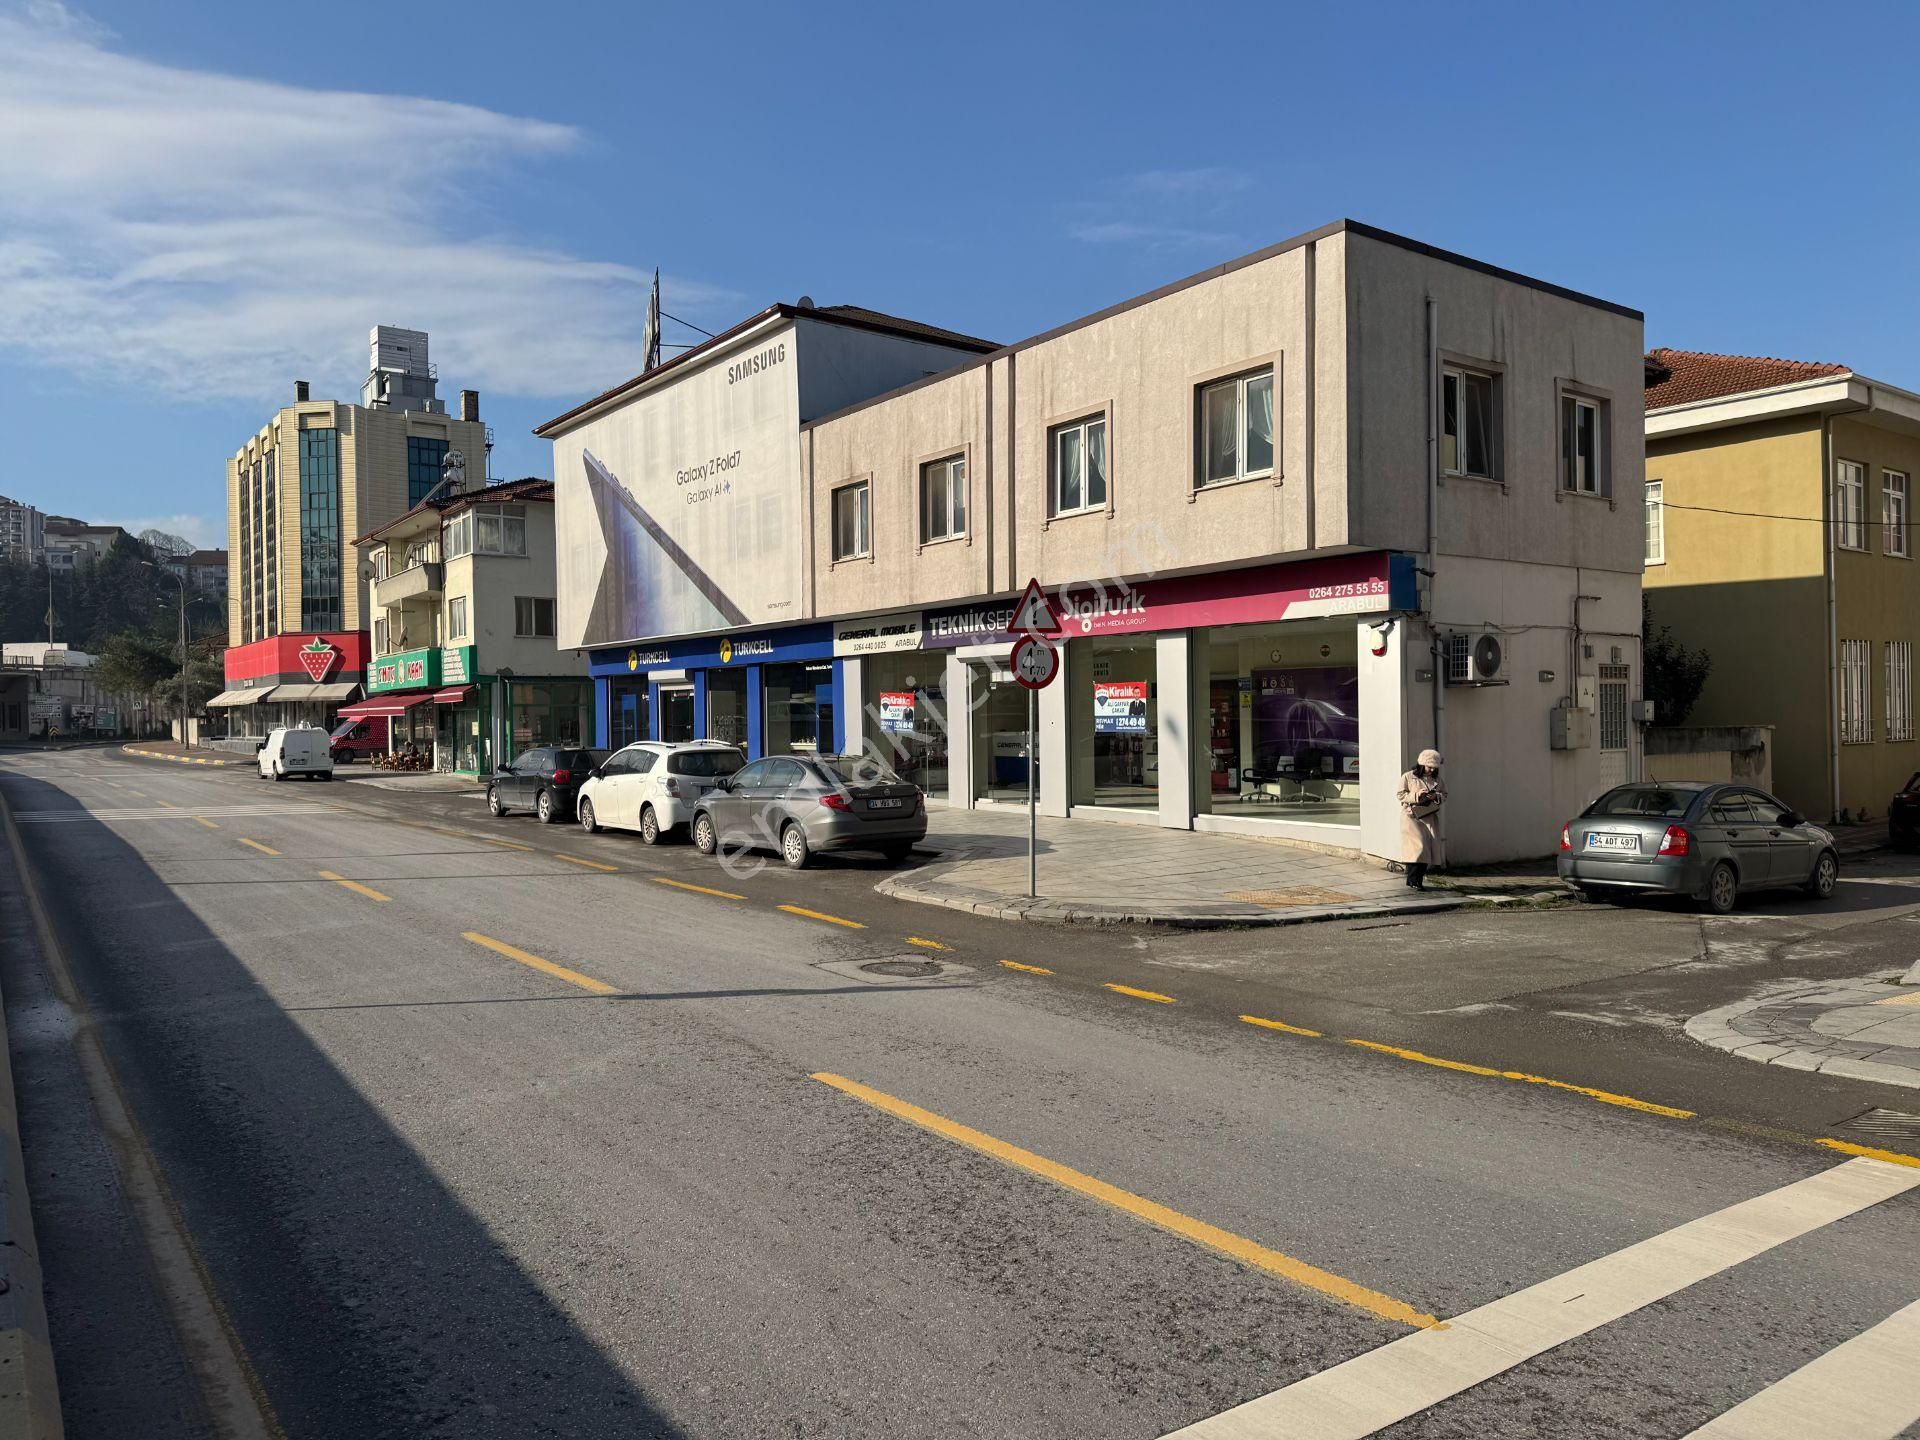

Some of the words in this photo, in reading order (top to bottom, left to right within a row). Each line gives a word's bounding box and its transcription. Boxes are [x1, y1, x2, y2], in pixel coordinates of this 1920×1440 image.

[728, 343, 785, 385] SAMSUNG
[676, 463, 708, 486] Galaxy
[709, 459, 715, 476] Z
[716, 450, 741, 473] Fold7
[686, 487, 713, 504] Galaxy
[714, 482, 722, 495] AI
[1309, 586, 1332, 599] 0264
[1334, 584, 1353, 597] 275
[1356, 583, 1368, 594] 55
[1371, 581, 1384, 593] 55
[1329, 597, 1383, 611] ARABUL
[929, 608, 987, 637] TEKNİK
[1107, 619, 1125, 627] MEDIA
[1125, 617, 1147, 626] GROUP
[838, 628, 878, 641] GENERAL
[880, 623, 917, 637] MOBILE
[734, 639, 774, 655] TURKCELL
[895, 638, 917, 647] ARABUL
[638, 650, 670, 664] TURKCELL
[1109, 685, 1134, 697] Kiralık
[1620, 838, 1634, 847] 497
